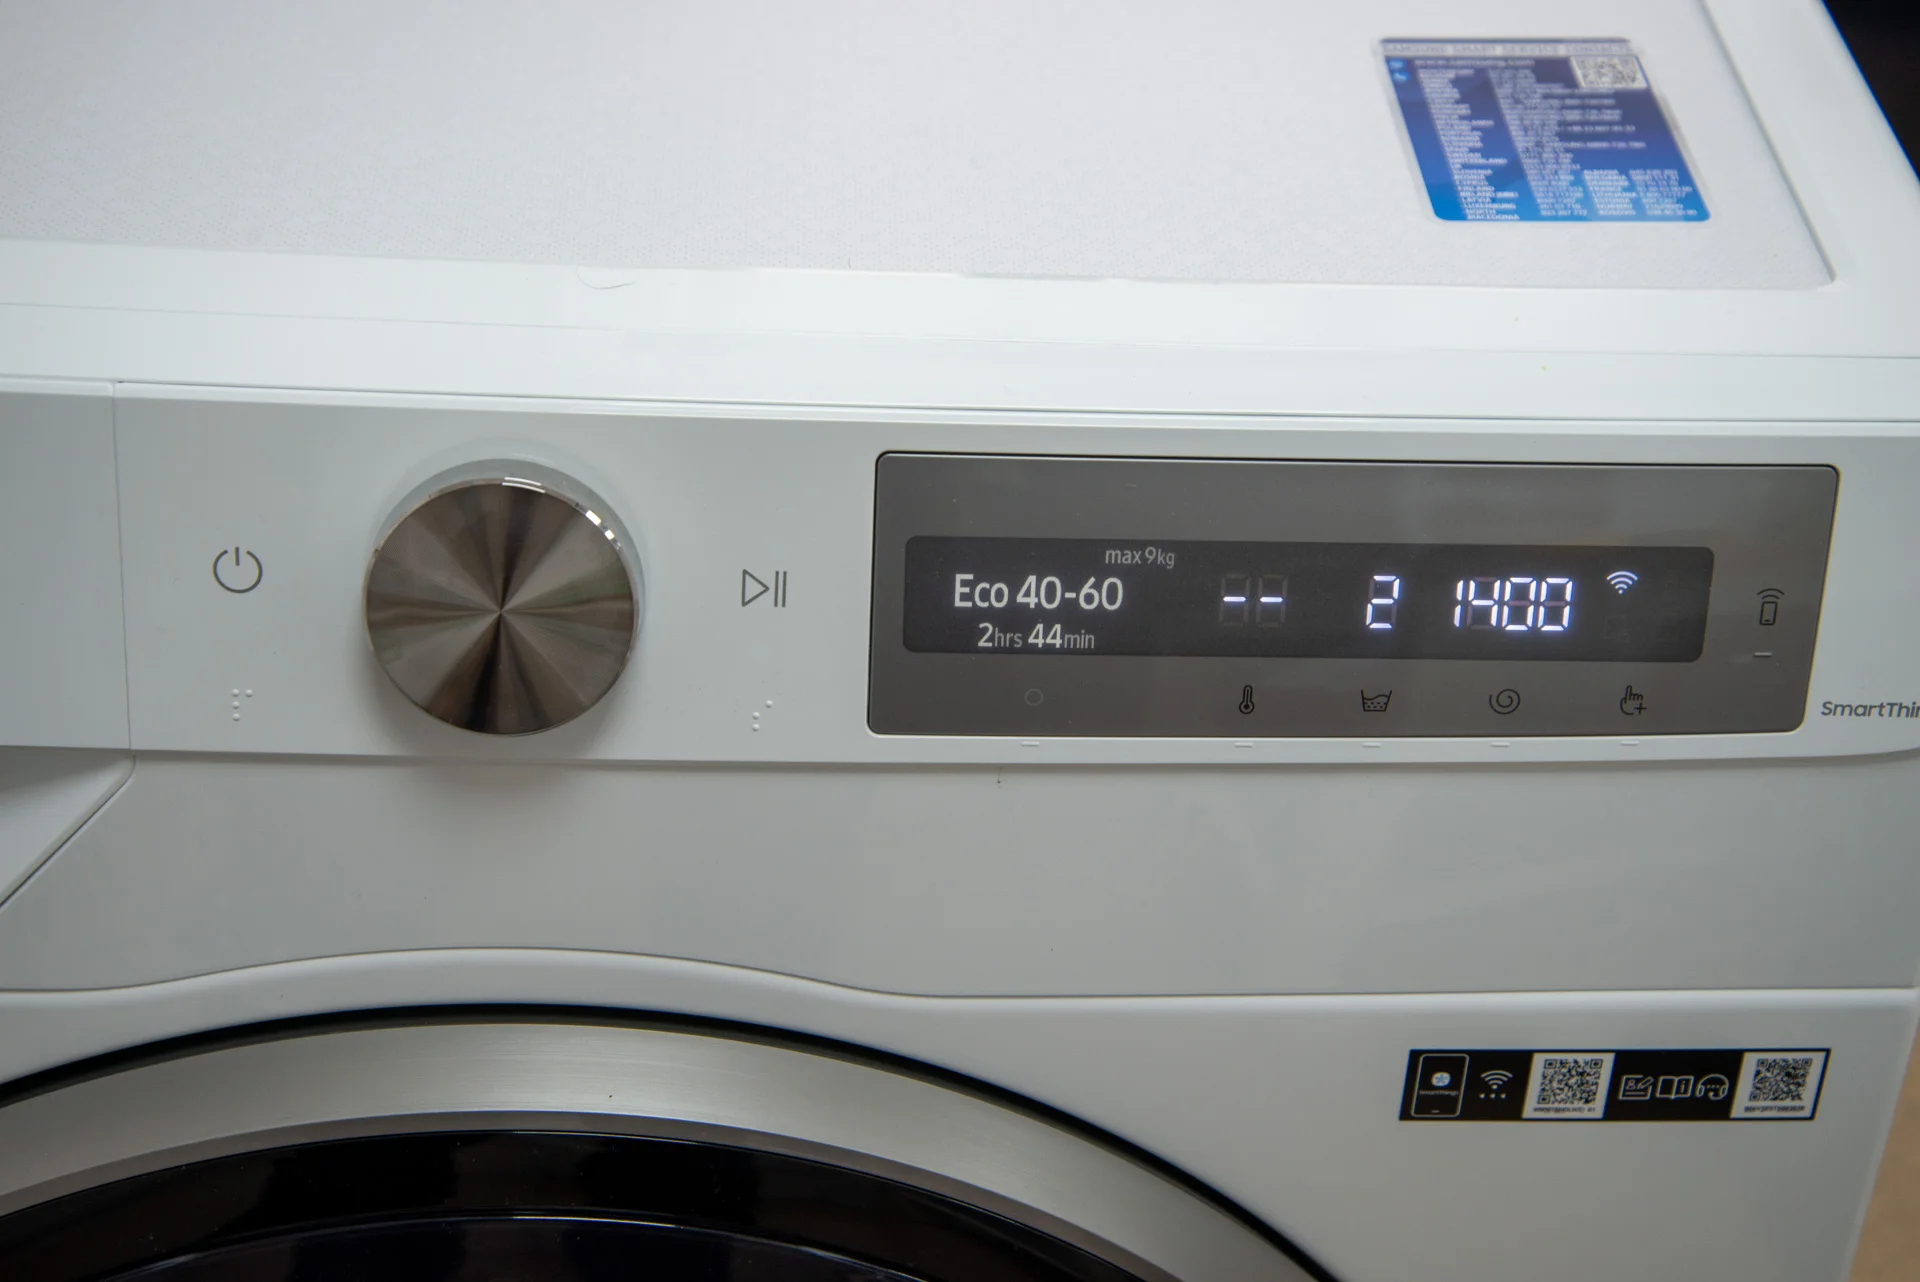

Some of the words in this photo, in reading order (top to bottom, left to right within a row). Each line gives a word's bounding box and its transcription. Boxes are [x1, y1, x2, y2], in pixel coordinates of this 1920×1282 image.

[1105, 550, 1141, 564] max
[1144, 547, 1175, 569] 9kg
[954, 573, 1009, 608] Eco
[1016, 575, 1124, 611] 40-60
[1365, 574, 1401, 630] 2
[1453, 576, 1574, 632] 1400
[977, 623, 1022, 648] 2hrs
[1028, 623, 1095, 650] 44min
